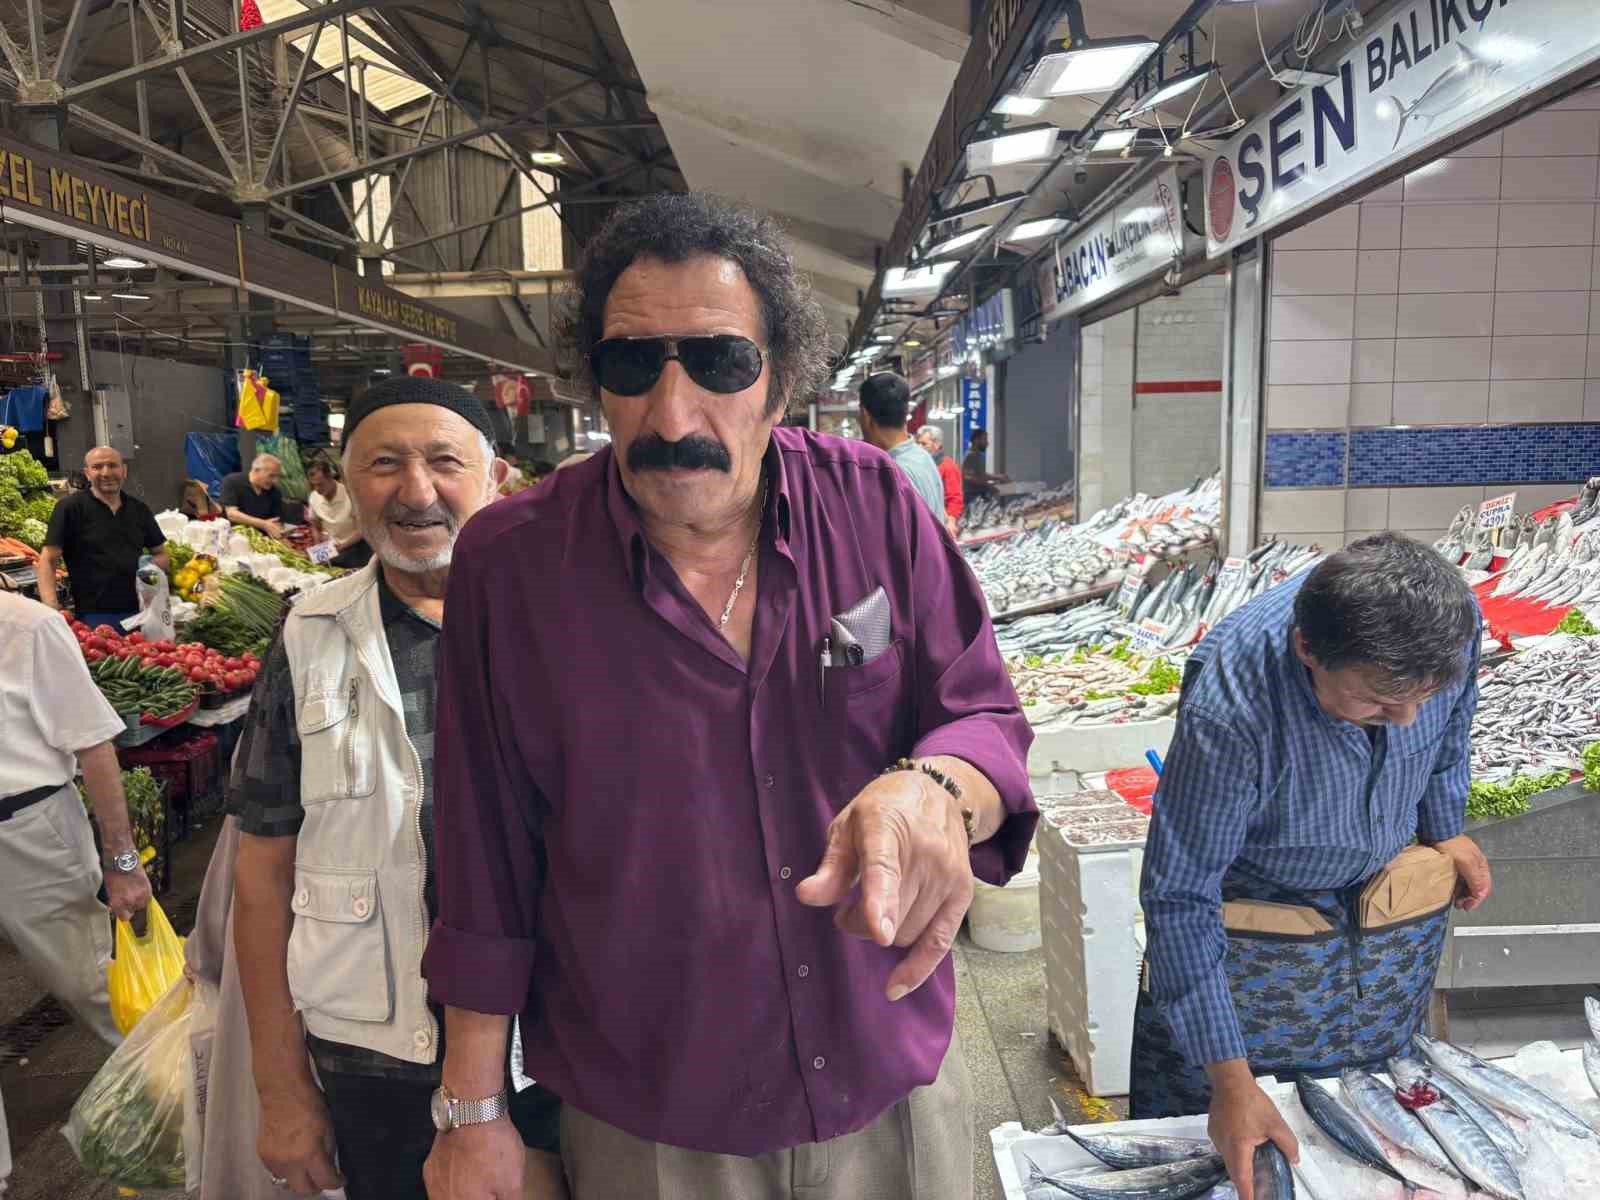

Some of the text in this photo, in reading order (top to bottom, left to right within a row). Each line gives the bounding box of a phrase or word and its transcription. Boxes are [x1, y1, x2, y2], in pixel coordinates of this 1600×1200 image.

[1238, 0, 1508, 229] ŞEN BALIKÇ
[50, 166, 150, 242] MEYVECİ
